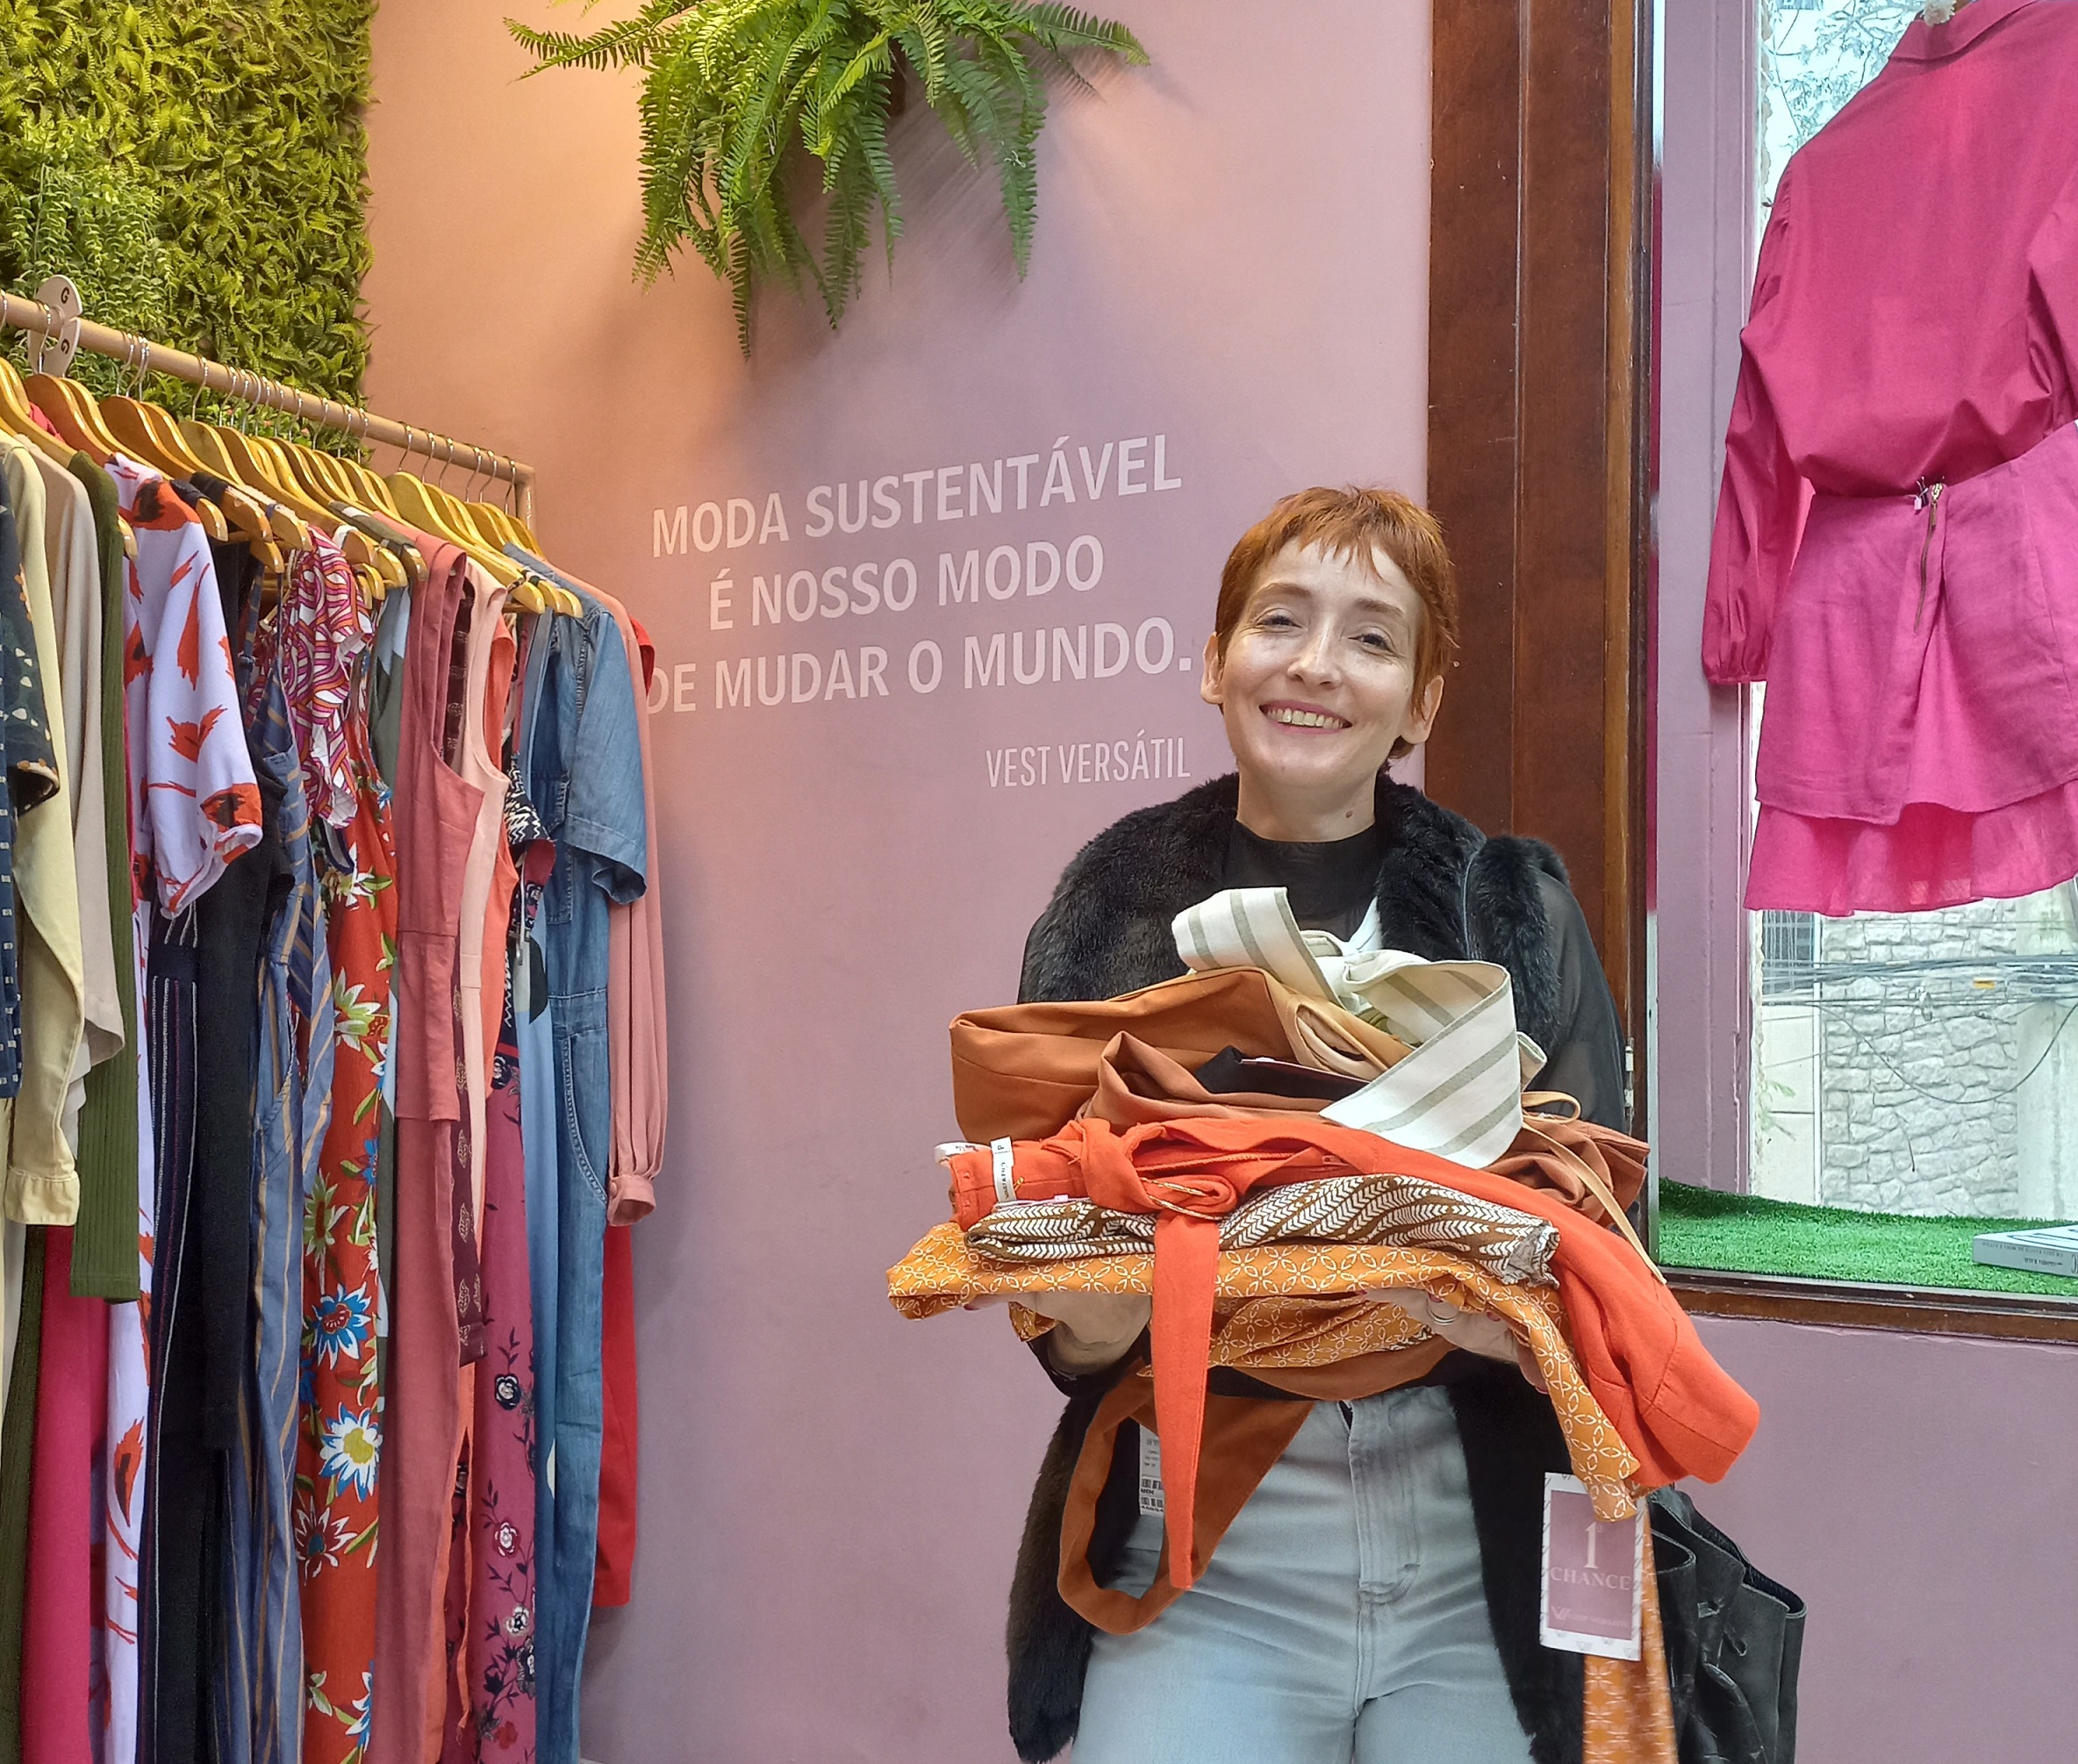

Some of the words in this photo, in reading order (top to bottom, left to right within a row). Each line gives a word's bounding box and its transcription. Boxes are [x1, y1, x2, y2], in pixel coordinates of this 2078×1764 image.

[61, 286, 70, 305] G
[653, 492, 790, 558] MODA
[805, 434, 1182, 538] SUSTENTÁVEL
[710, 568, 734, 631] É
[752, 558, 918, 627] NOSSO
[938, 534, 1104, 606] MODO
[646, 663, 697, 714] DE
[715, 646, 890, 710] MUDAR
[907, 640, 942, 694] O
[964, 617, 1193, 690] MUNDO.
[985, 745, 1051, 788] VEST
[1058, 729, 1191, 784] VERSÁTIL
[1551, 1567, 1631, 1590] CHANCE
